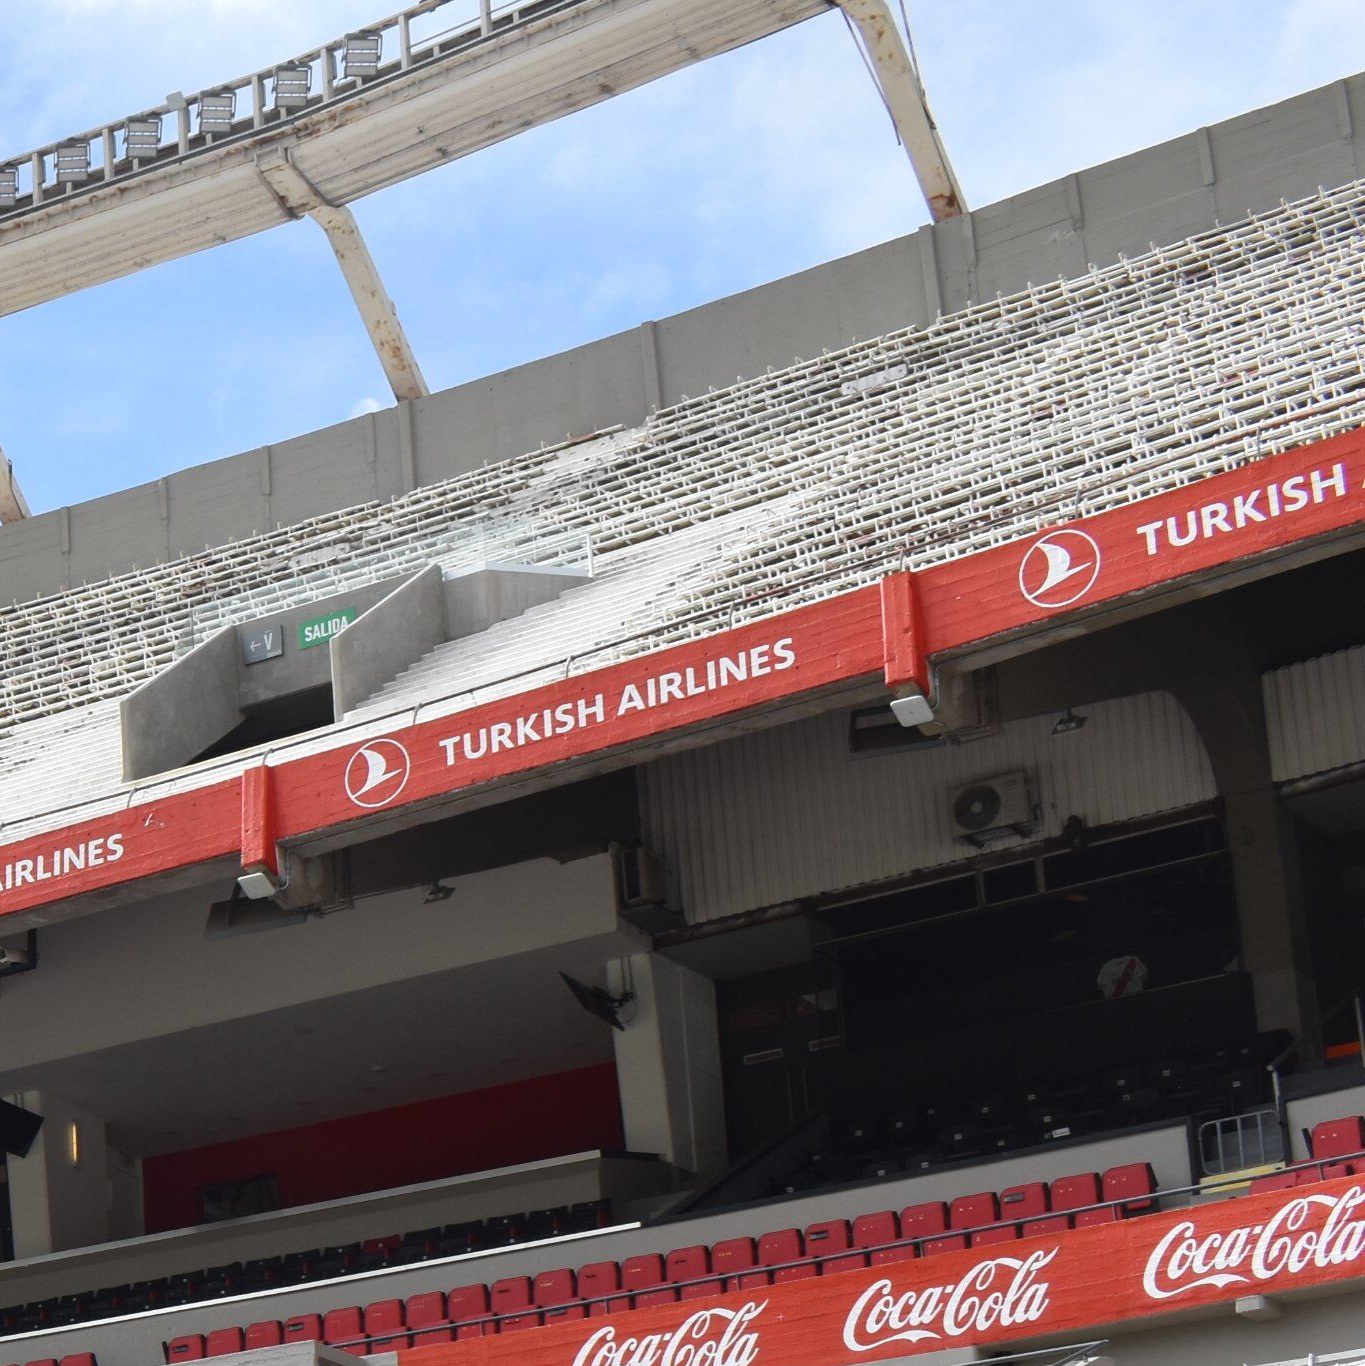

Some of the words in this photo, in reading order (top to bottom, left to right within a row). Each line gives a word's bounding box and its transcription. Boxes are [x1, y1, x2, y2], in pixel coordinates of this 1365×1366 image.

[1136, 462, 1347, 556] TURKISH
[263, 632, 273, 651] V
[304, 615, 350, 642] SALIDA
[439, 693, 605, 767] TURKISH
[618, 637, 796, 717] AIRLINES
[1142, 1185, 1365, 1300] Coca-Cola
[843, 1246, 1059, 1352] Coca-Cola
